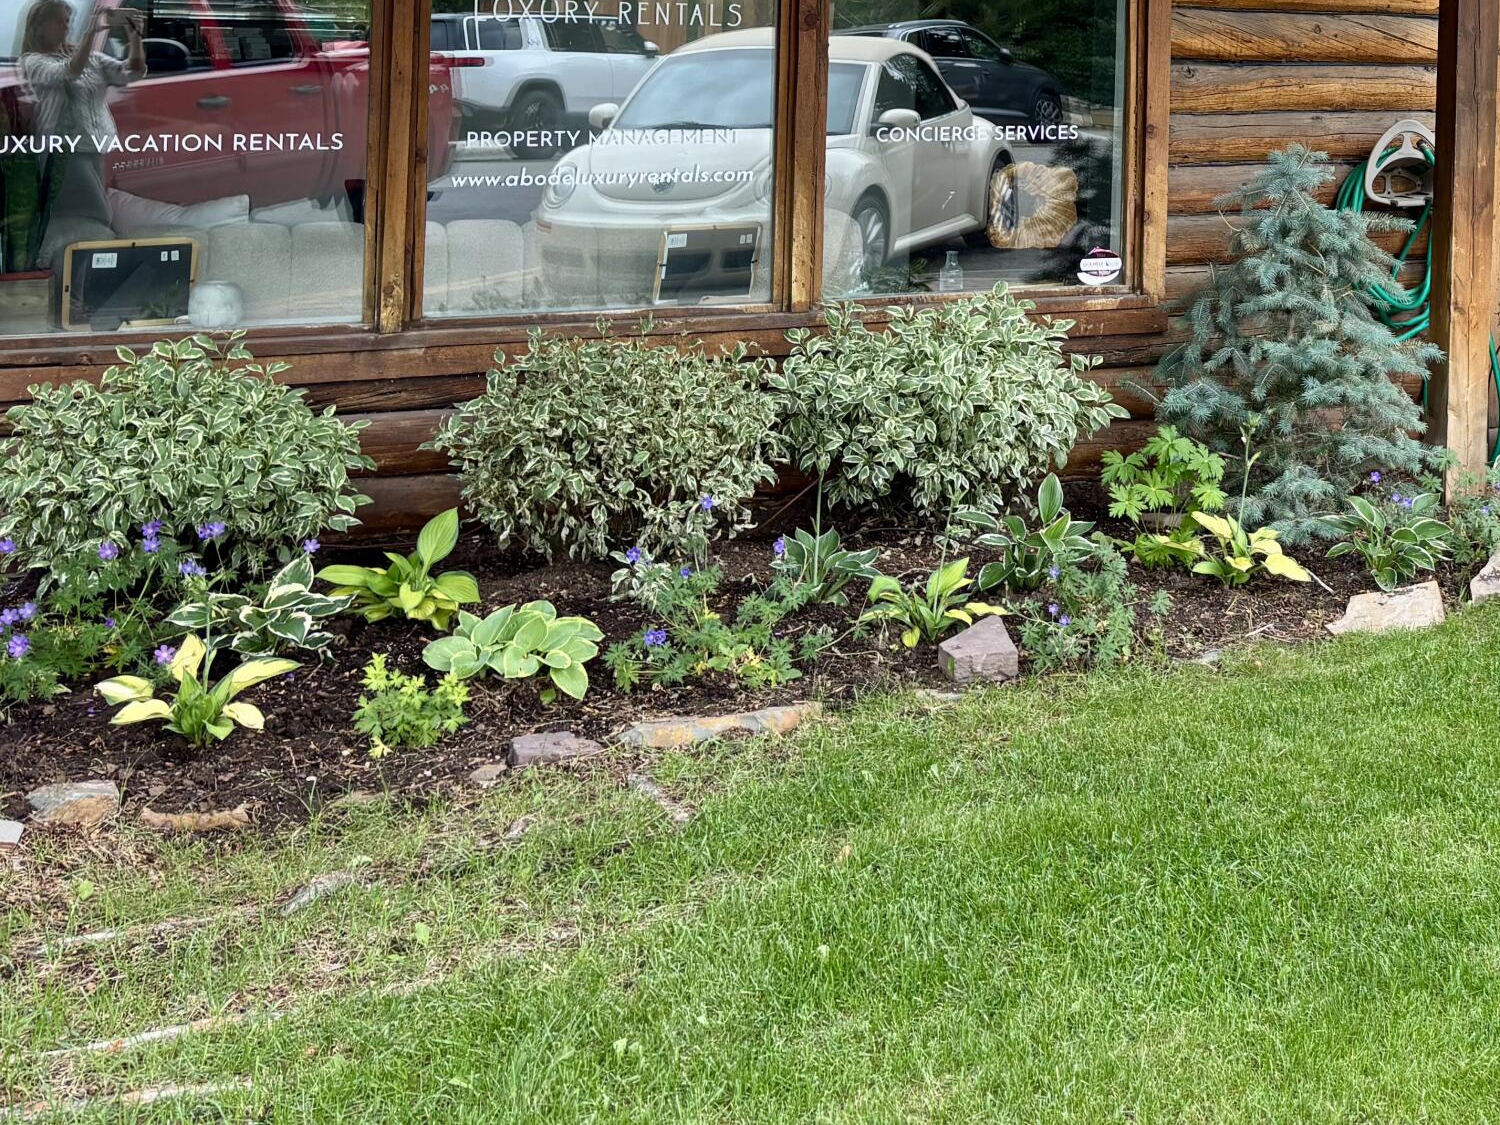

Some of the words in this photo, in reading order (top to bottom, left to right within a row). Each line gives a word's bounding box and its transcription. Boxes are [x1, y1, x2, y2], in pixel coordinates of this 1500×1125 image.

[618, 1, 743, 27] RENTALS
[91, 133, 223, 152] VACATION
[233, 132, 344, 151] RENTALS
[466, 129, 582, 148] PROPERTY
[588, 129, 740, 147] MANAGEMENT
[876, 126, 988, 142] CONCIERGE
[993, 124, 1079, 141] SERVICES
[451, 163, 754, 188] www.abodeluxuryrentals.com
